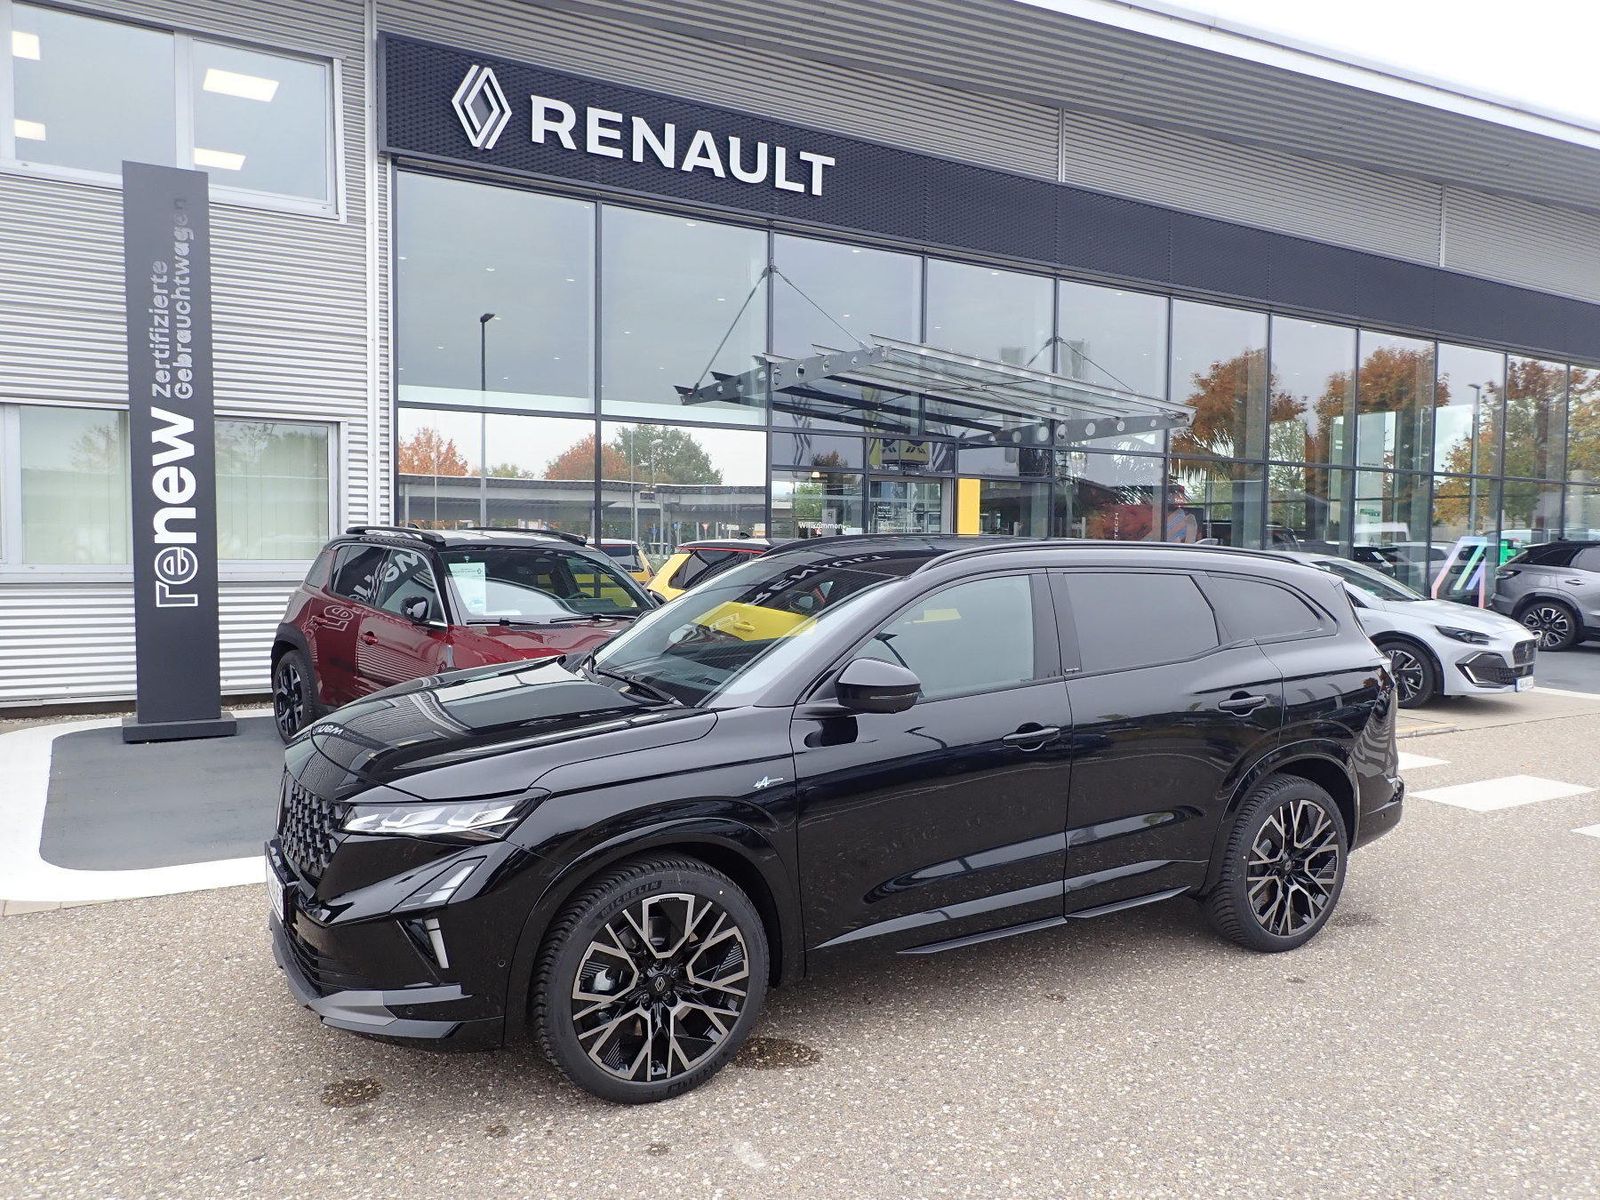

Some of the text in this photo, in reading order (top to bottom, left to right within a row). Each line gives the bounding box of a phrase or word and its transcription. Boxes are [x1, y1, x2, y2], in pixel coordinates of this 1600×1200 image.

[530, 94, 836, 196] RENAULT
[149, 260, 171, 399] Zertifizierte
[171, 197, 194, 400] Gebrauchtwagen
[151, 406, 199, 608] renew
